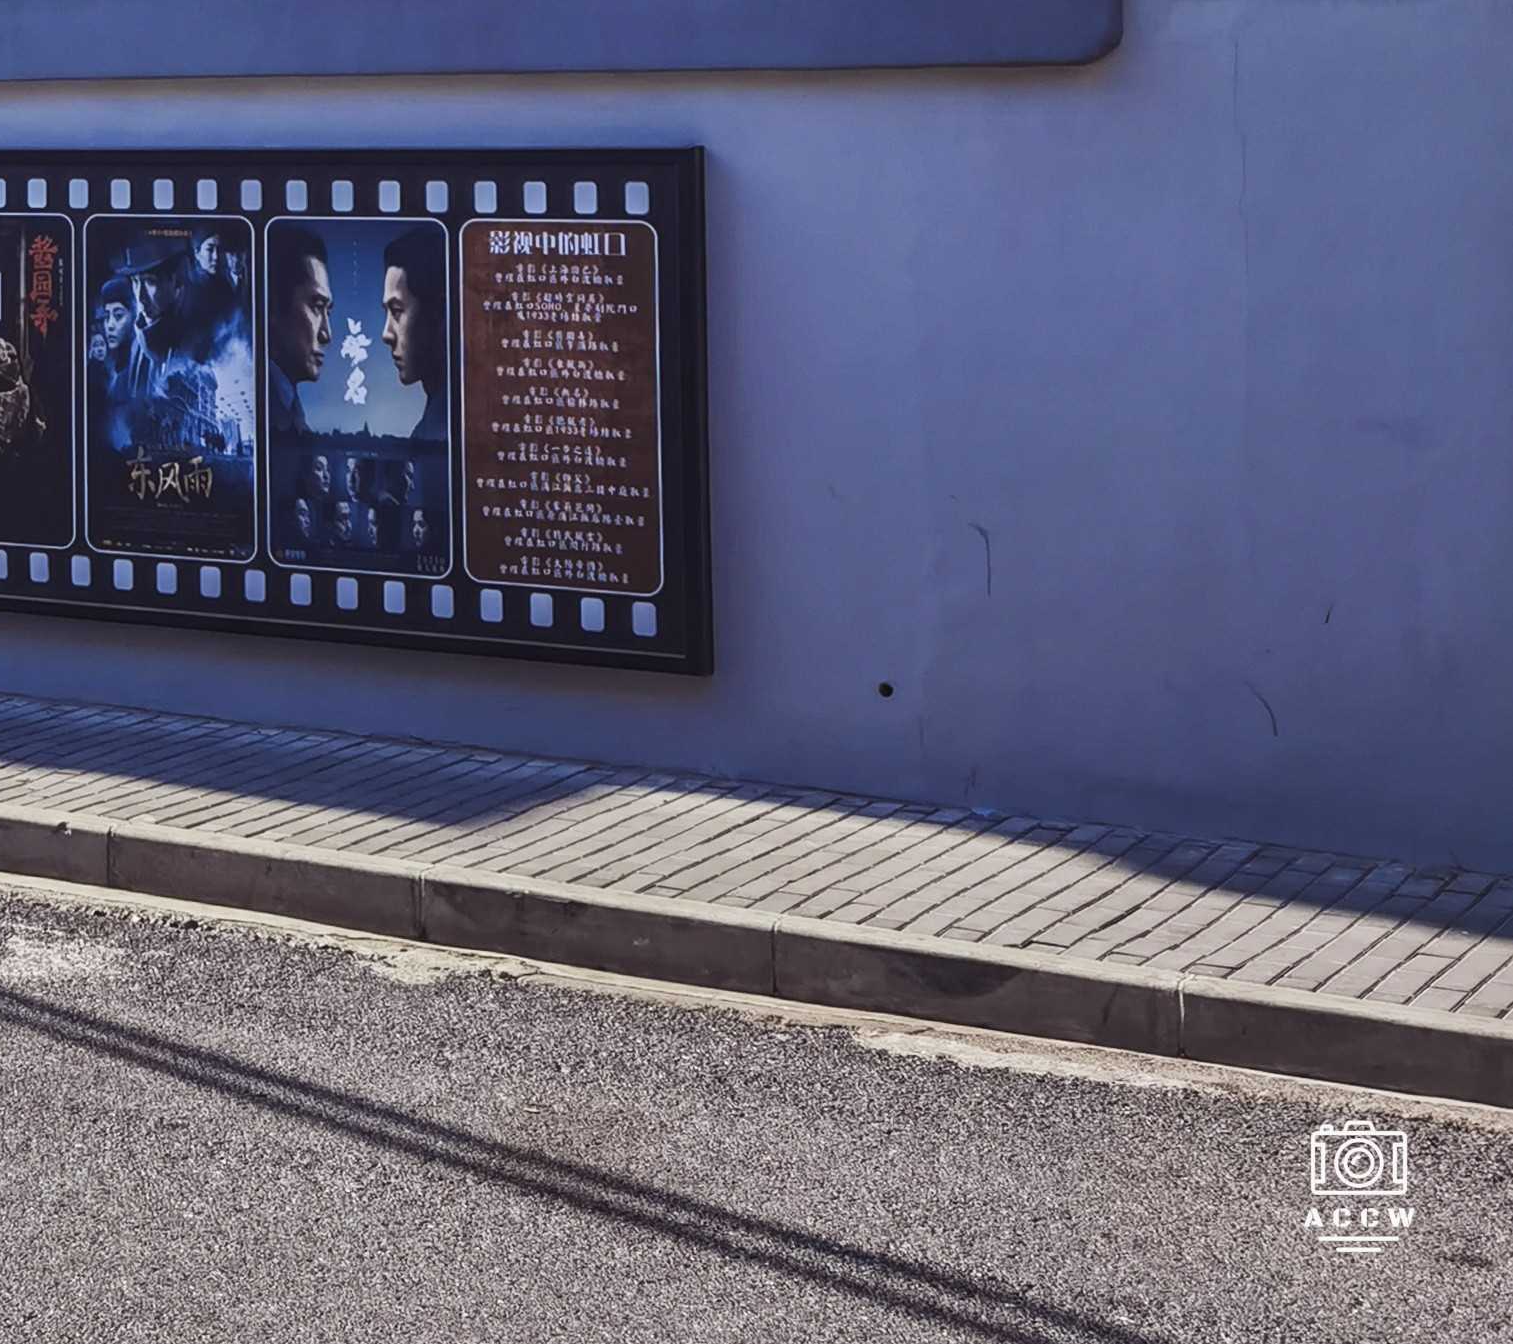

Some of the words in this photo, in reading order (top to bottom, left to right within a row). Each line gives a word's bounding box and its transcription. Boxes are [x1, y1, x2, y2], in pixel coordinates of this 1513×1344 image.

[489, 230, 626, 256] 影视中的虹口
[126, 445, 213, 503] 东风雨
